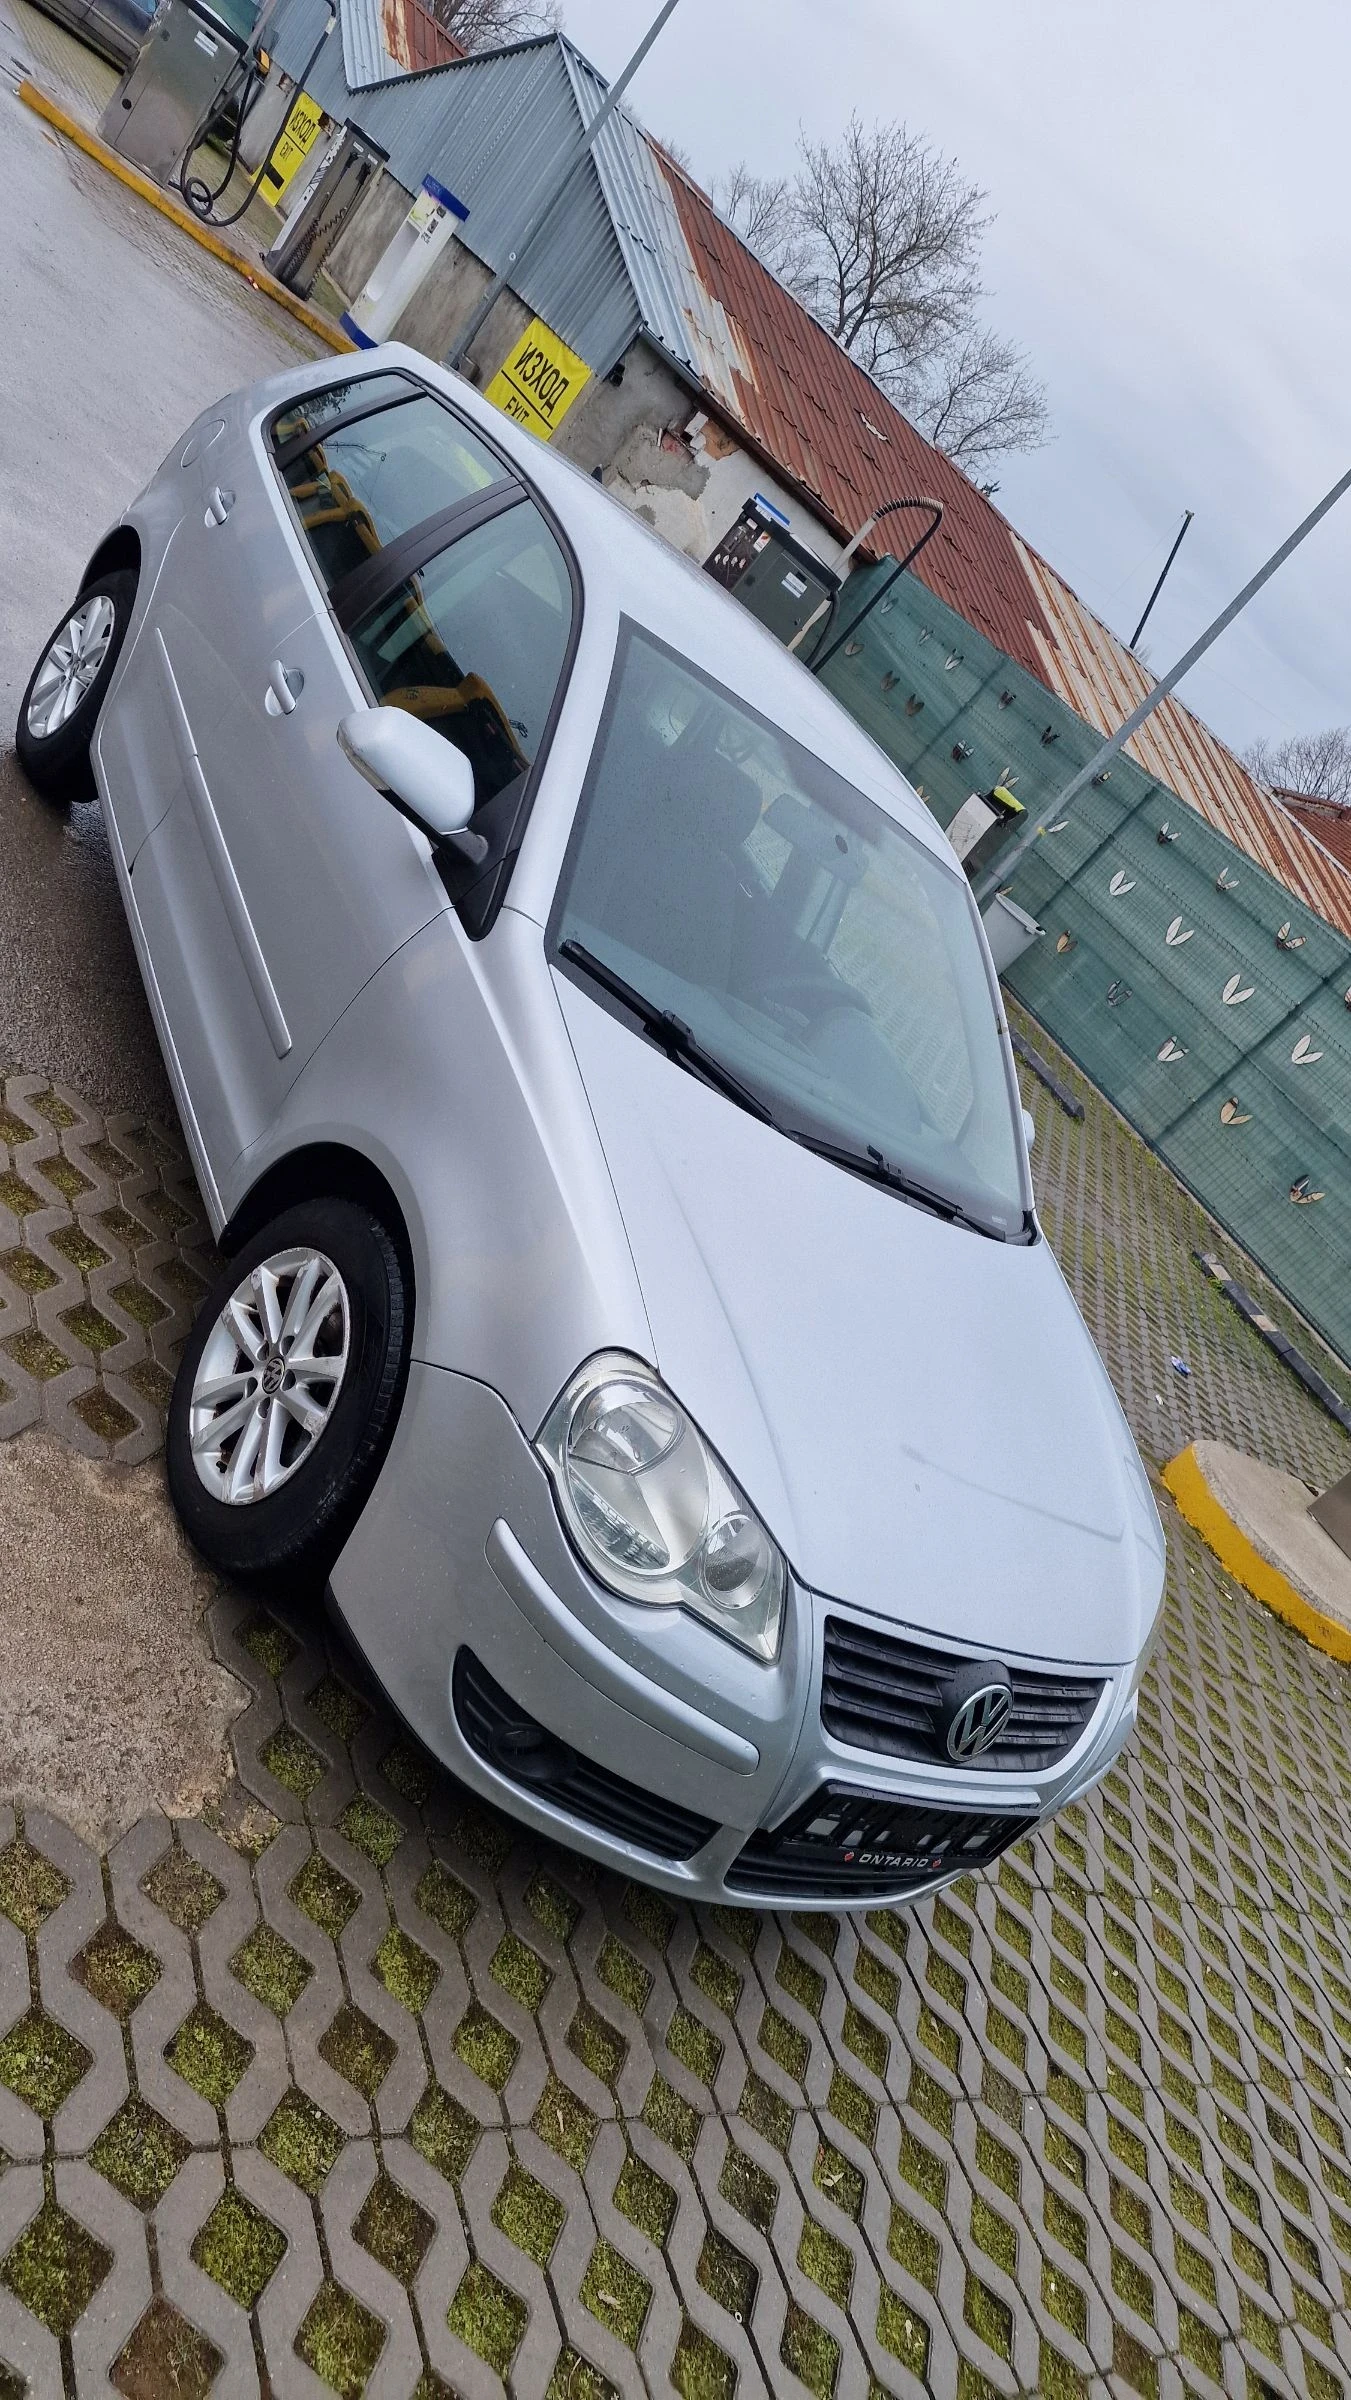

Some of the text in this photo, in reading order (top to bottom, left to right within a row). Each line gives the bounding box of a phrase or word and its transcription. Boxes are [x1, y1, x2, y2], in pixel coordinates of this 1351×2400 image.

[513, 341, 570, 418] ИЗХОД
[948, 1686, 1011, 1760] VW
[858, 1853, 929, 1868] ONTARIO
